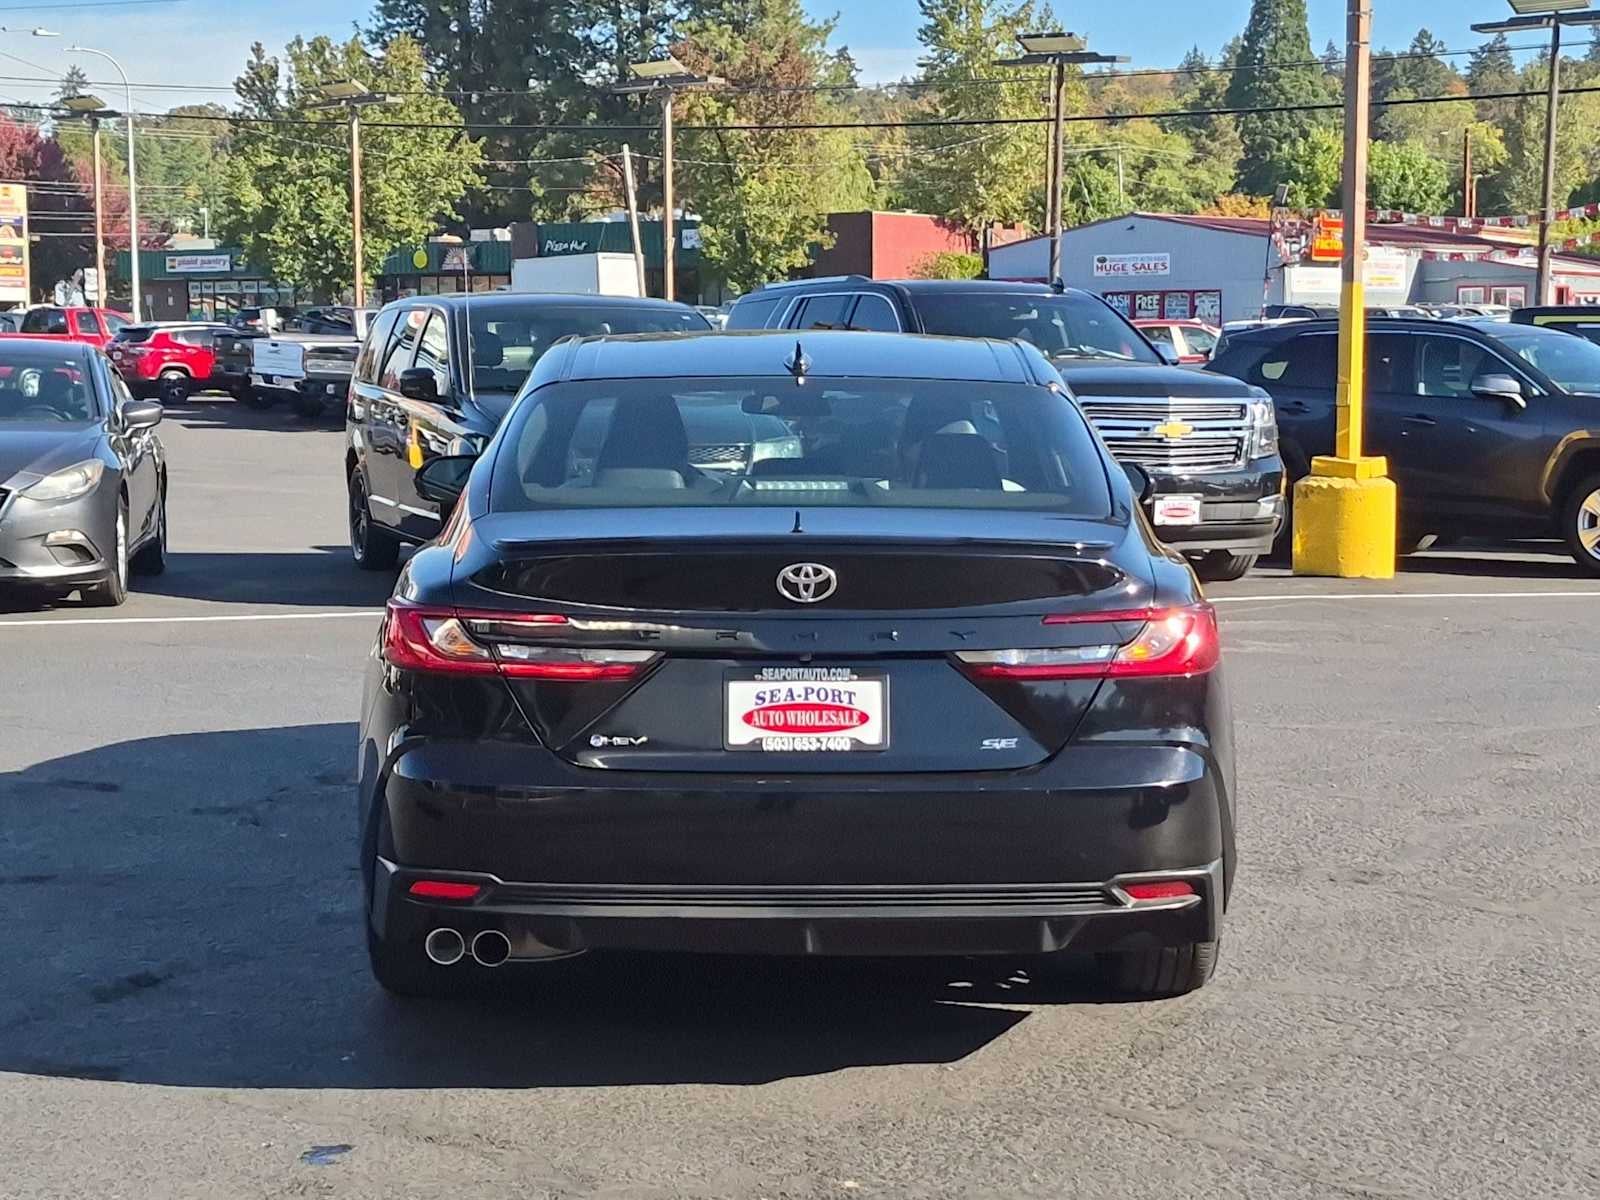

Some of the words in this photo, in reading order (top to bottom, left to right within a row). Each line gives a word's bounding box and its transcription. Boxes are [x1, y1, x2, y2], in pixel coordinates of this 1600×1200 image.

[544, 240, 569, 253] Pizza
[570, 239, 588, 251] Hut
[199, 257, 225, 267] pantry
[1096, 263, 1128, 272] HUGE
[1131, 262, 1168, 271] SALES
[1106, 294, 1130, 308] CASH
[1135, 294, 1160, 310] FREE
[762, 667, 851, 680] SEAPORTAUTO.COM
[754, 686, 857, 706] SEA-PORT
[751, 710, 784, 726] AUTO
[786, 709, 861, 727] WHOLESALE
[761, 736, 851, 752] (503)653-7400
[979, 737, 1018, 750] SE
